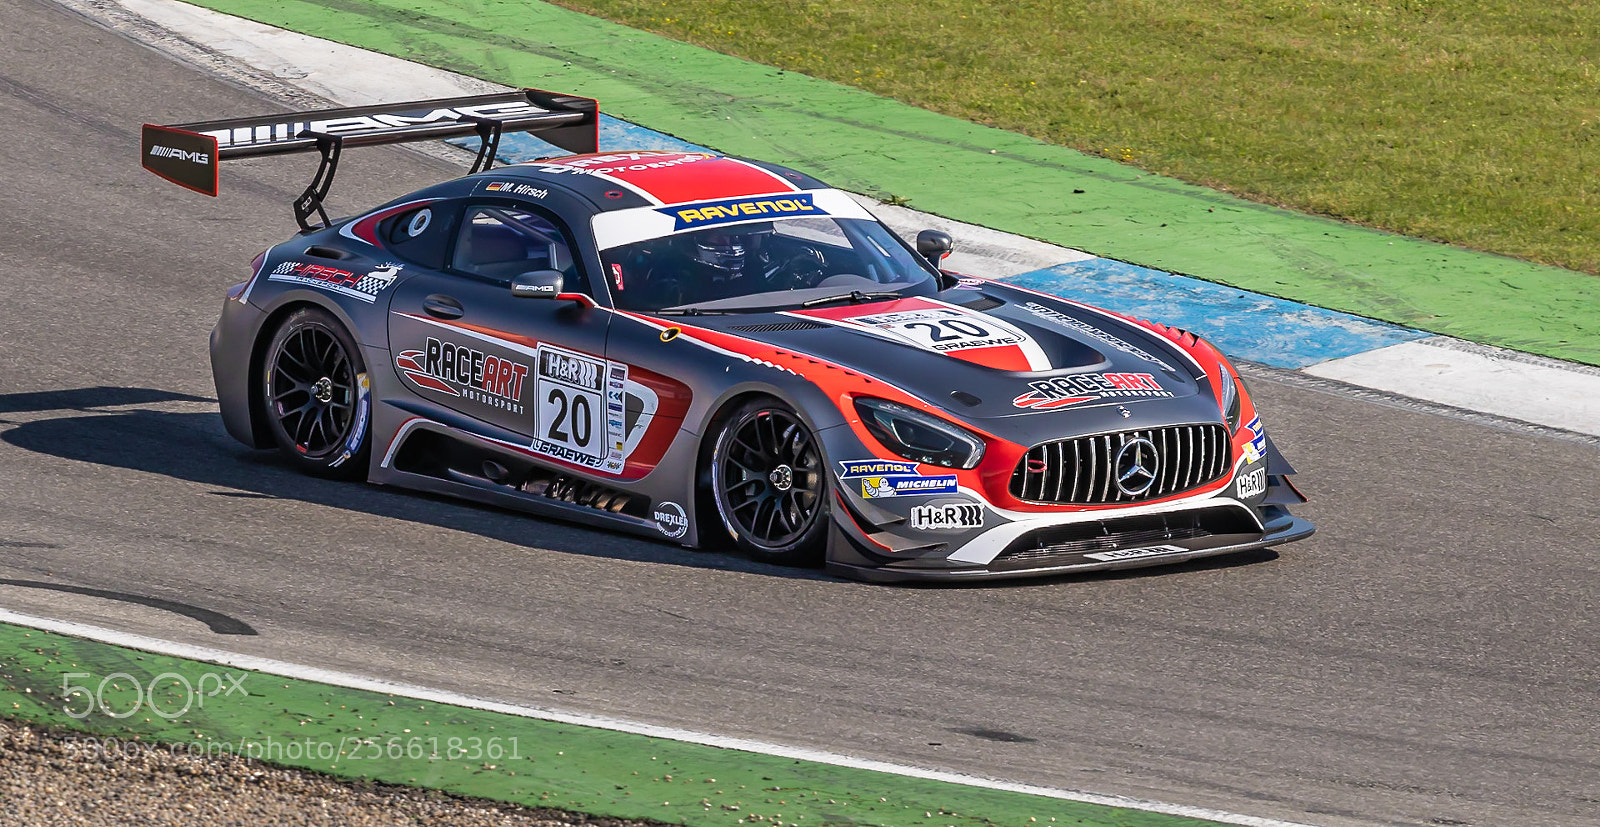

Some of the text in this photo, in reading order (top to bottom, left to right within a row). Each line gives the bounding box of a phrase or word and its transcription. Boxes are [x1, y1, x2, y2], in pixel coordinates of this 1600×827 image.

[308, 101, 550, 134] AMG
[169, 149, 209, 165] AMG
[499, 182, 549, 200] M. Hirsch
[676, 198, 815, 224] RAVENOL
[289, 263, 364, 289] HIRSCH
[904, 319, 990, 343] 20
[932, 336, 1018, 351] GRAEWE
[425, 336, 529, 402] RACEART
[549, 353, 580, 385] H&R
[1028, 372, 1164, 400] RACEART
[462, 388, 525, 415] MOTORSPORT
[547, 388, 592, 448] 20
[540, 442, 598, 467] GRAEWE
[850, 464, 912, 474] RAVENOL
[896, 478, 956, 489] MICHELIN
[653, 511, 688, 528] DREXLER
[918, 508, 957, 525] H&R
